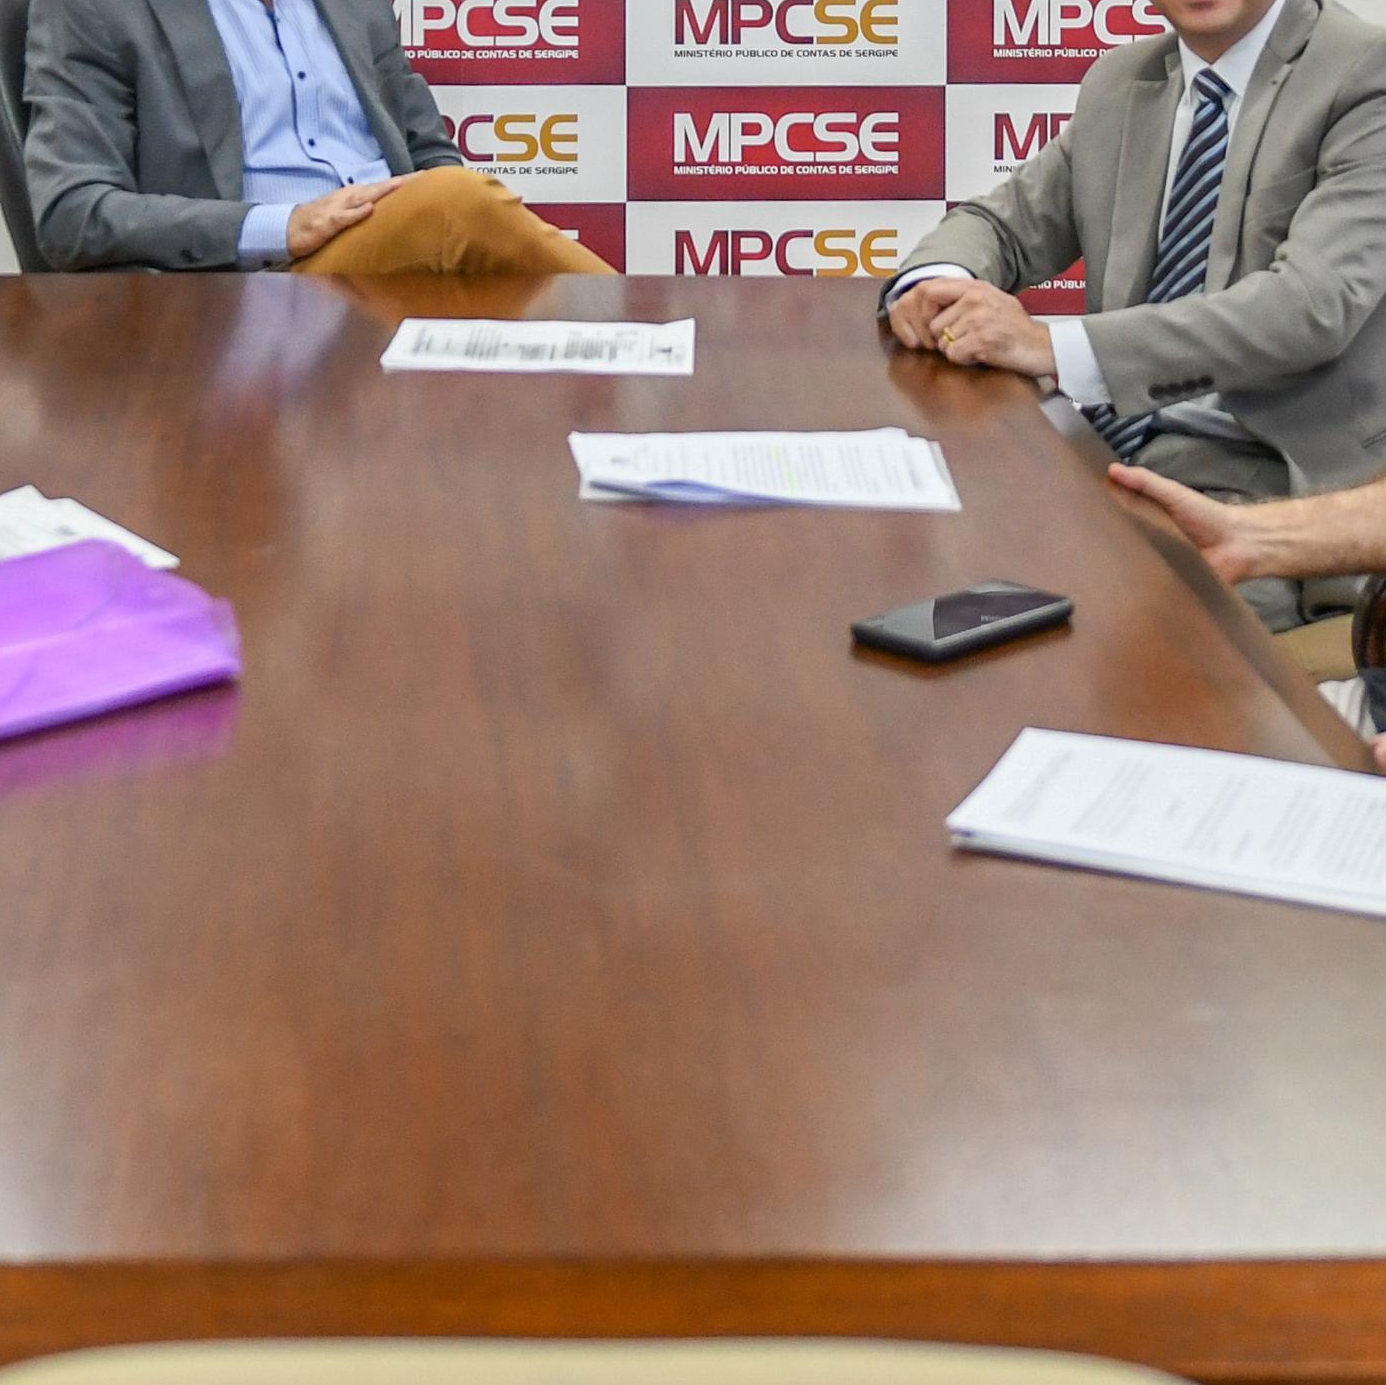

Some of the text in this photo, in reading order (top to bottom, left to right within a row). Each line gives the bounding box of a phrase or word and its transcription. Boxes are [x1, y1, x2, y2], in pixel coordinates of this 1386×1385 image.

[674, 113, 898, 162] MPCSE
[780, 165, 793, 175] DE
[795, 165, 836, 175] CONTAS
[838, 165, 852, 175] DE
[854, 165, 898, 175] SERGIPE
[675, 230, 898, 275] MPCSE
